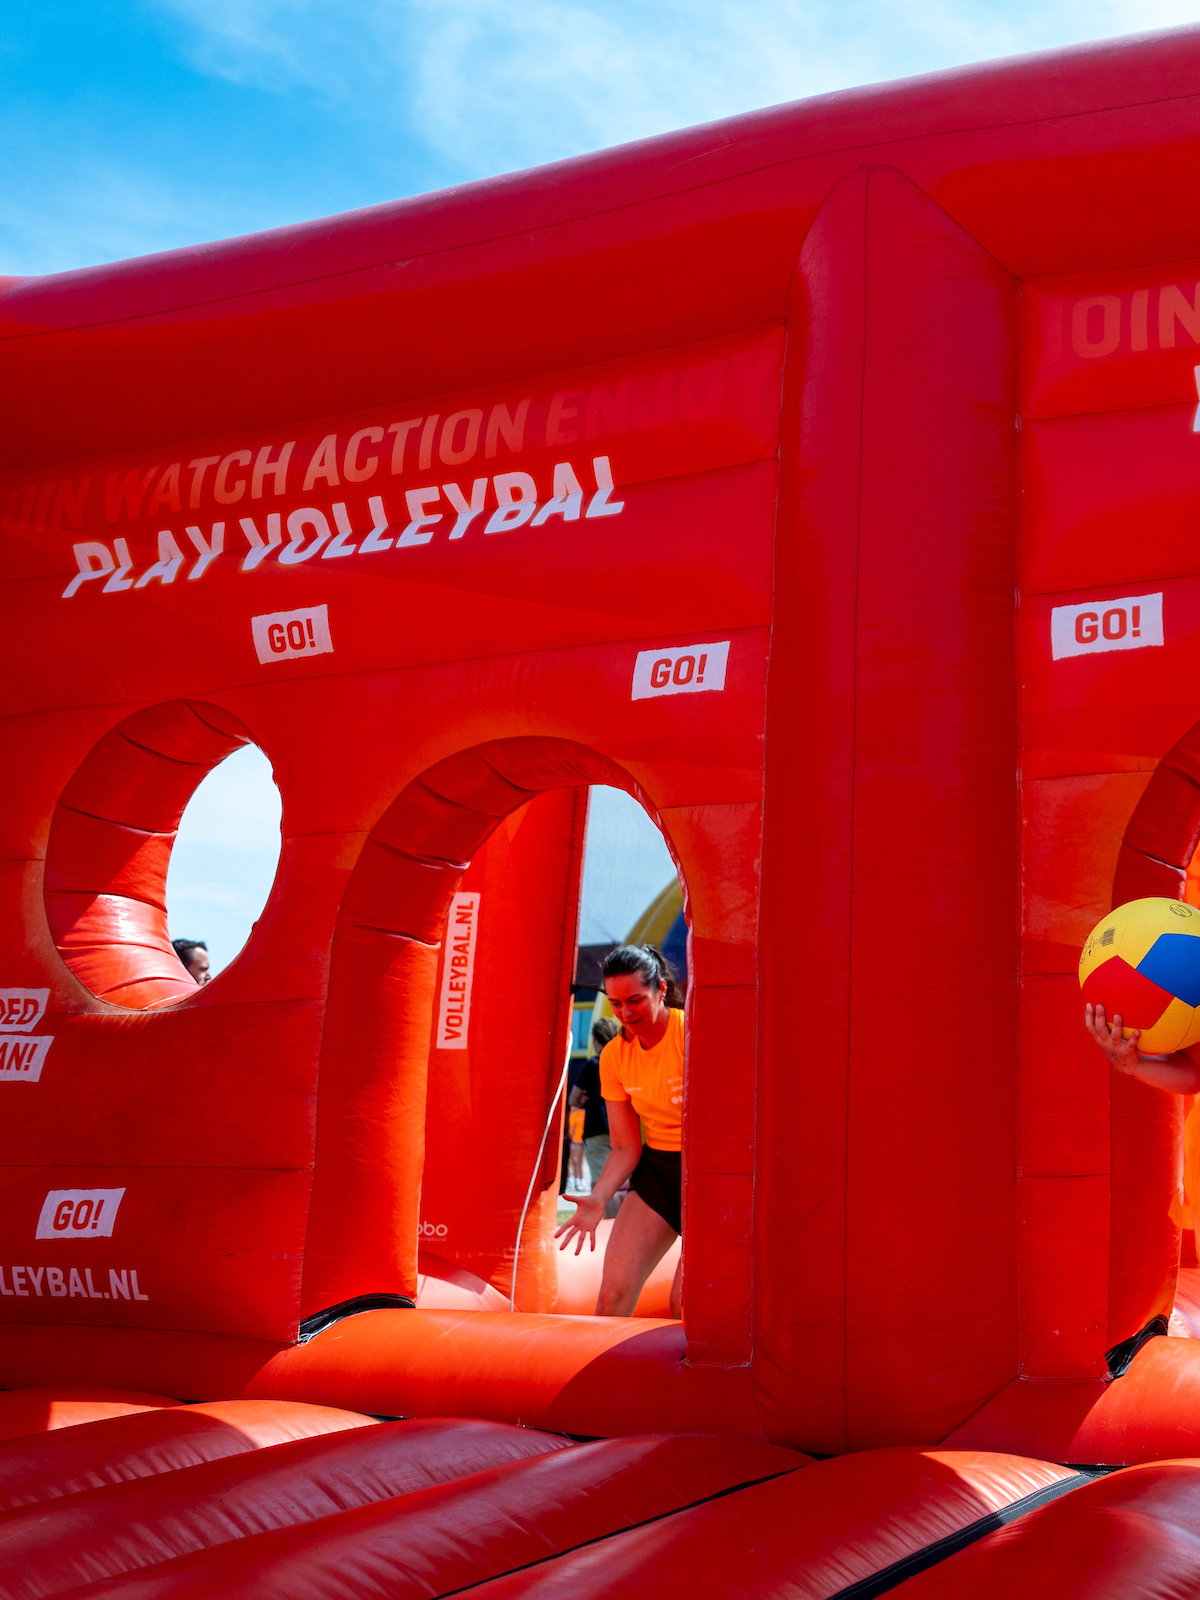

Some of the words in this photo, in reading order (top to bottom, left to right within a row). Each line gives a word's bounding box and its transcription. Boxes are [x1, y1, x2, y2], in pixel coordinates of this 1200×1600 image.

[103, 441, 296, 524] WATCH
[302, 399, 530, 491] ACTION
[61, 521, 226, 599] PLAY
[240, 455, 626, 572] VOLLEYBAL
[267, 618, 315, 653] GO!
[1074, 606, 1142, 644] GO!
[649, 653, 707, 690] GO!
[445, 901, 474, 1040] VOLLEYBAL.NL
[53, 1200, 104, 1231] GO!
